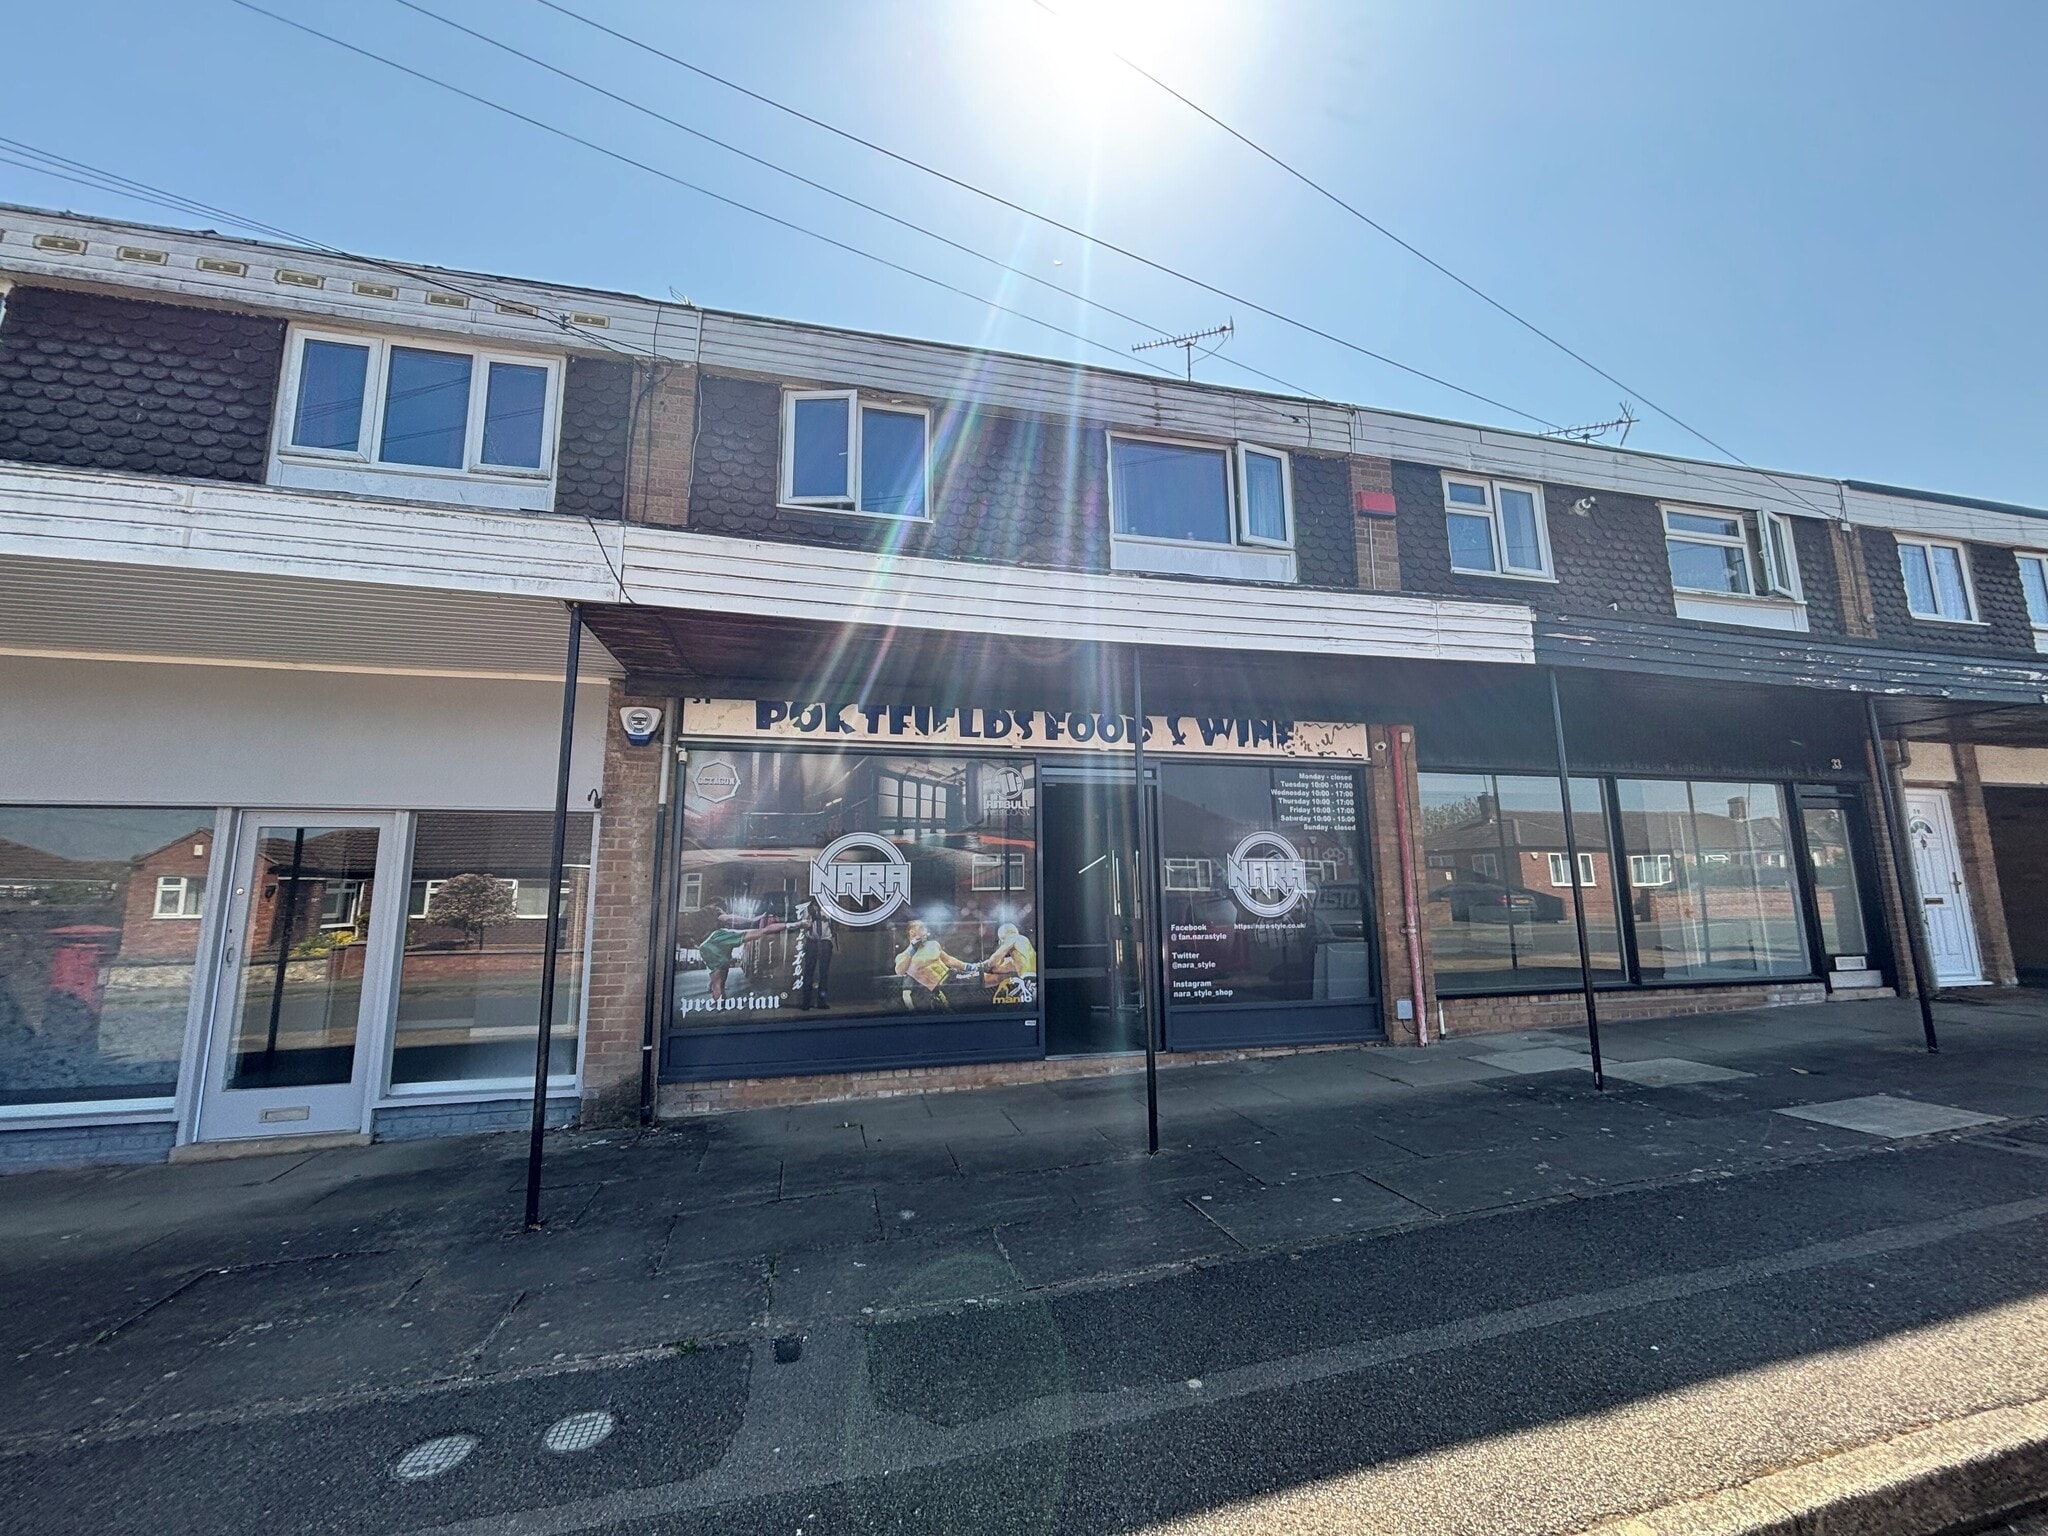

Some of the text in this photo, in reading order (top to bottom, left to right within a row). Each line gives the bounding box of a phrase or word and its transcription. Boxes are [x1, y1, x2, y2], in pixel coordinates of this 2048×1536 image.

[1830, 758, 1842, 770] 33
[697, 777, 736, 786] OCTAGON
[1280, 781, 1309, 789] Tuesday
[1271, 789, 1310, 797] Wednesday
[1278, 797, 1310, 806] Thursday
[1289, 806, 1311, 814] Friday
[1280, 815, 1311, 823] Saturday
[1303, 823, 1329, 832] Sunday
[1227, 852, 1308, 900] NARA
[809, 857, 912, 906] NARA
[1178, 933, 1227, 941] fan.narastyle
[1172, 961, 1216, 970] @nara_style
[1173, 980, 1212, 988] Instagram
[1173, 989, 1233, 998] nara_style_shop
